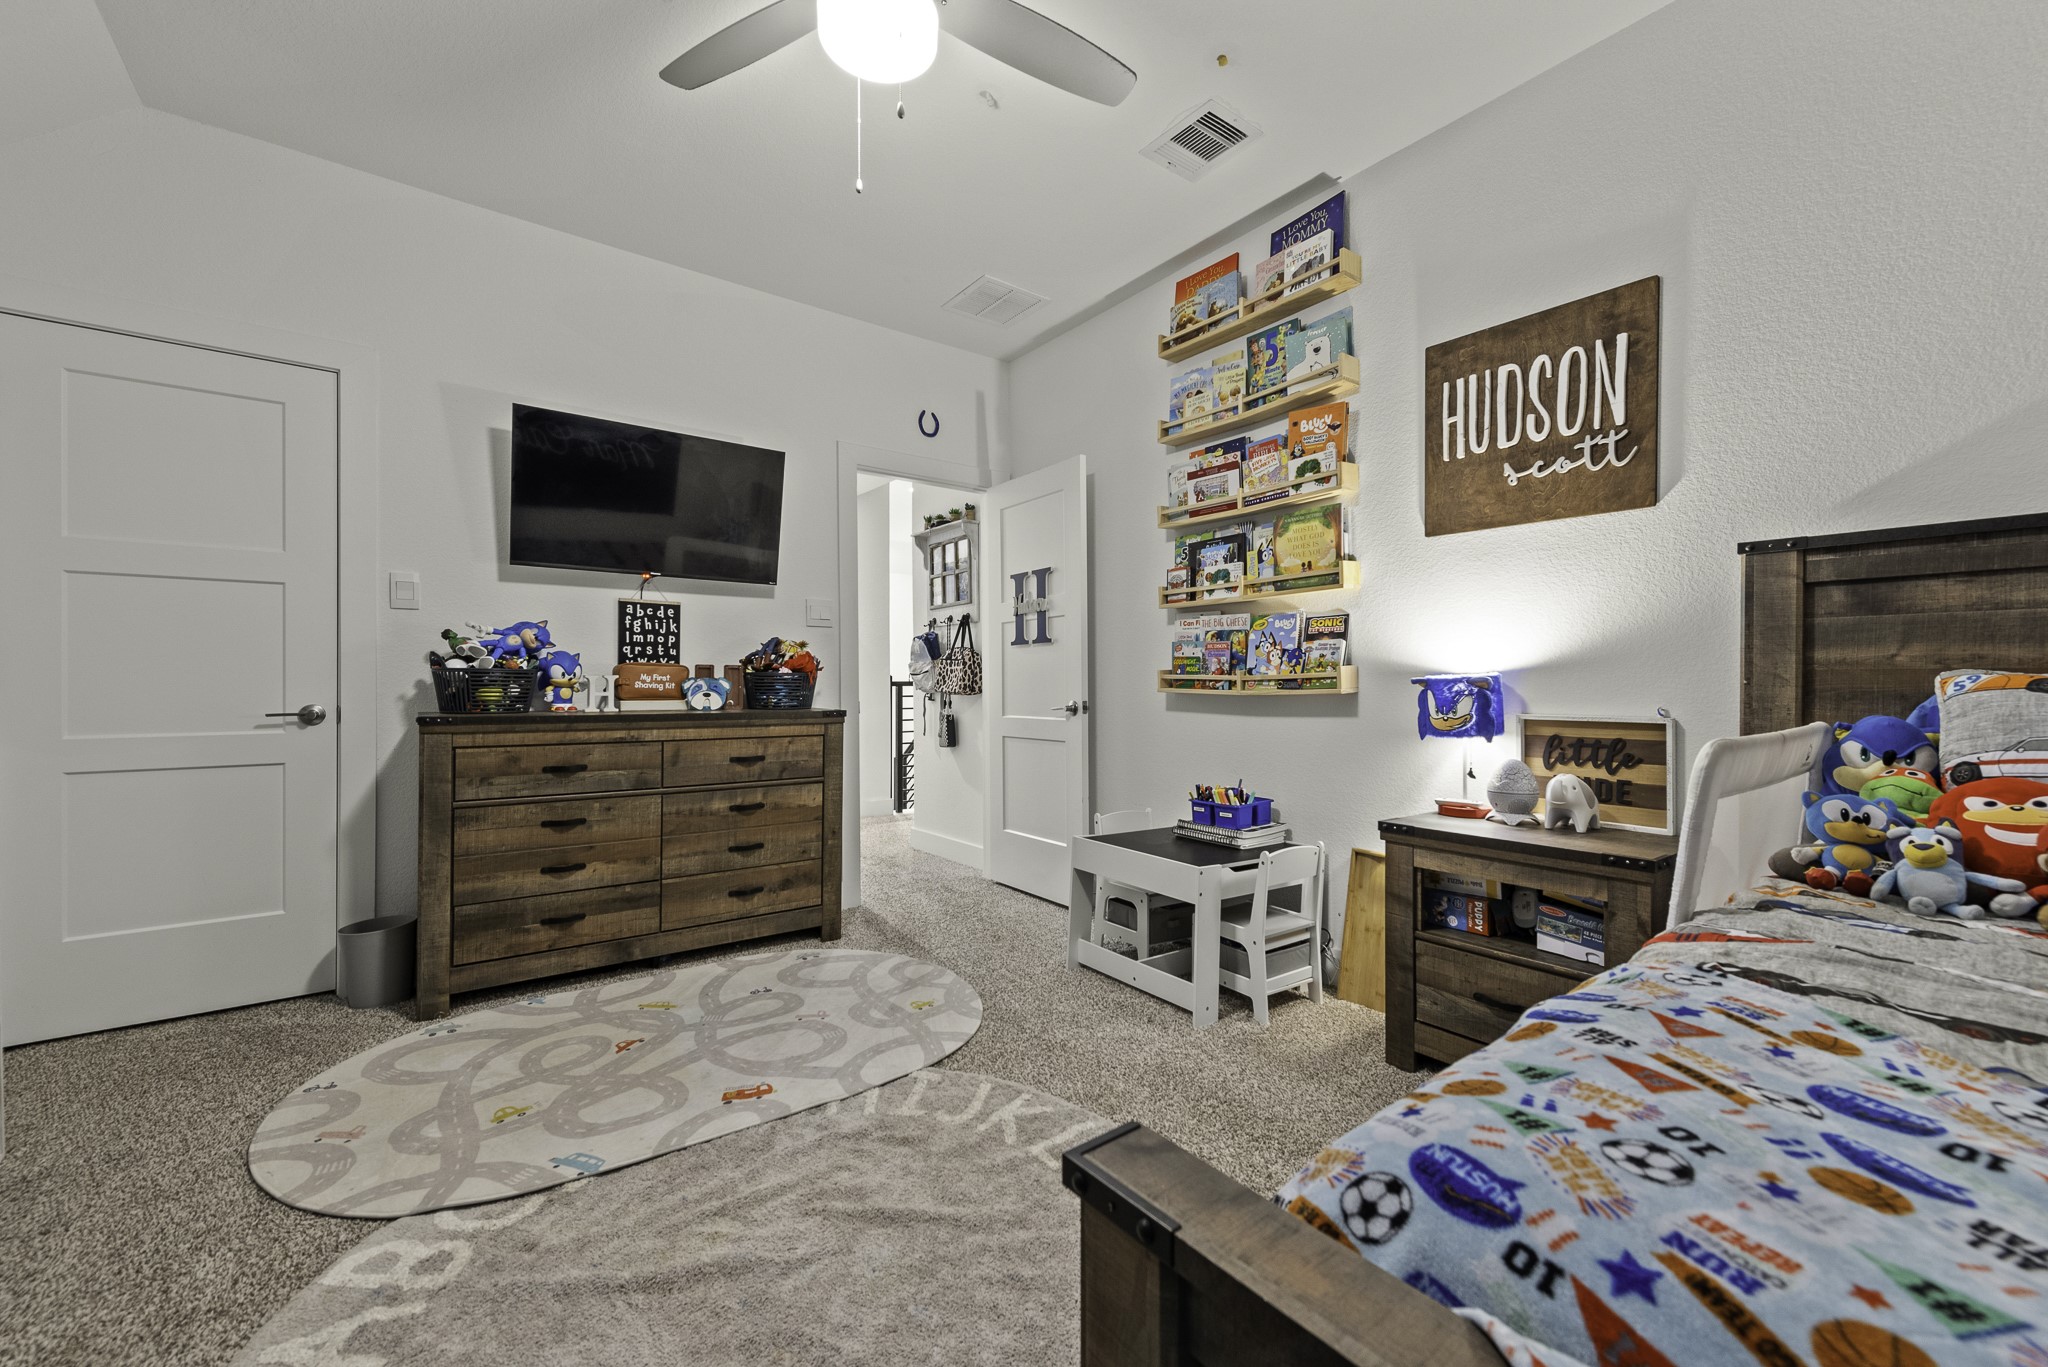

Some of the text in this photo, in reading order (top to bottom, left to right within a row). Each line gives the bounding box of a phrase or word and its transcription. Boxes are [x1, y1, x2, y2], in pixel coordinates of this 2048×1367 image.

[1282, 215, 1329, 250] MOMMY
[1288, 219, 1308, 236] Love
[1310, 209, 1327, 221] You
[1309, 244, 1328, 257] BABY
[1190, 271, 1208, 286] Love
[1209, 265, 1224, 276] You
[1265, 331, 1279, 367] 5
[1442, 332, 1630, 462] HUDSON
[1503, 428, 1639, 487] scott
[1287, 531, 1325, 543] WHAT GOD
[1292, 524, 1318, 534] MOSTLY
[1289, 551, 1306, 559] LOVE
[1202, 616, 1248, 628] THE BIG CHEESE
[1310, 617, 1344, 628] SONIC
[634, 681, 664, 691] Shaving
[640, 673, 671, 682] My First
[1952, 674, 1982, 692] 59
[1542, 733, 1645, 777] little
[1474, 901, 1484, 933] PUPPY
[1658, 1125, 1727, 1158] 10
[1938, 1142, 2015, 1174] 10
[1501, 1240, 1567, 1300] 10
[1659, 1229, 1768, 1297] RUN
